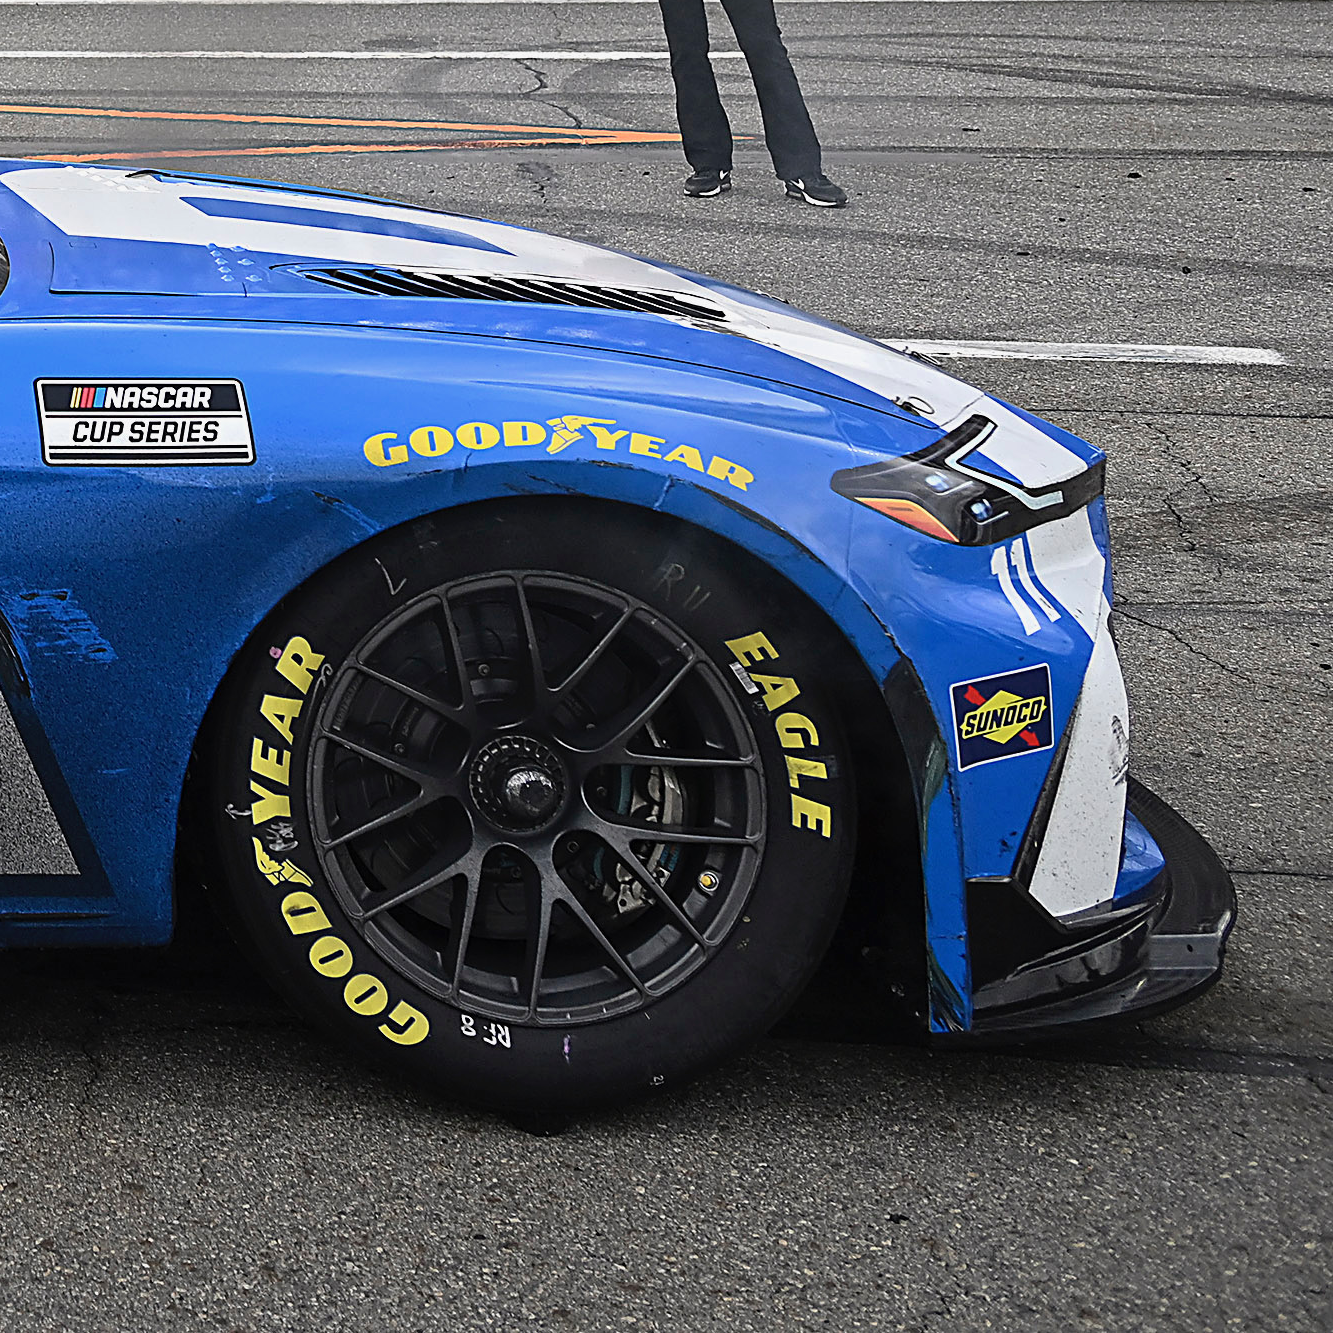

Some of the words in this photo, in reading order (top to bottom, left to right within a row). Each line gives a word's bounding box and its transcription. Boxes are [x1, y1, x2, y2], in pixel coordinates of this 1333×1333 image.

[103, 385, 211, 411] NASCAR
[72, 420, 124, 445] CUP
[127, 418, 220, 444] SERIES
[989, 537, 1062, 637] 11
[724, 630, 832, 839] EAGLE
[963, 698, 1045, 739] SUNOCO
